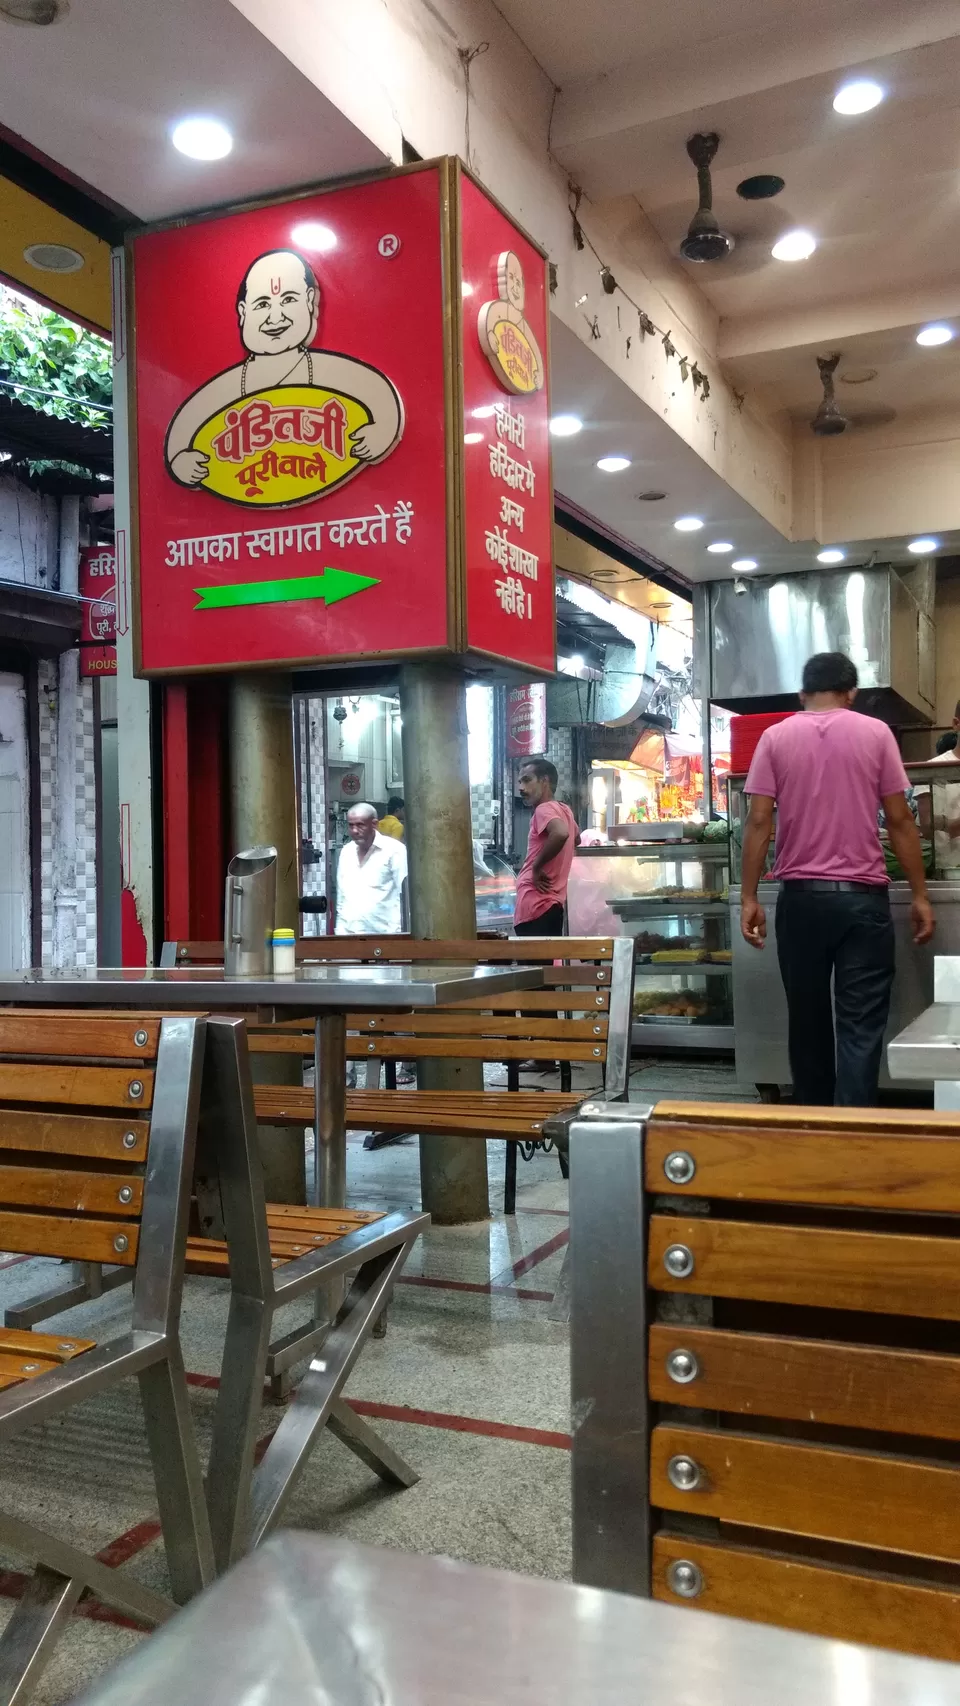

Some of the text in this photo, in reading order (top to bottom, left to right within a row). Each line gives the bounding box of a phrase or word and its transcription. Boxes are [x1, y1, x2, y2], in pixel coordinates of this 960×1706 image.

[212, 398, 347, 461] पंडितजी
[499, 496, 525, 533] अन्य
[165, 500, 414, 567] आपका स्वागत करते हैं
[88, 552, 116, 576] हरि
[88, 660, 117, 670] HOUS
